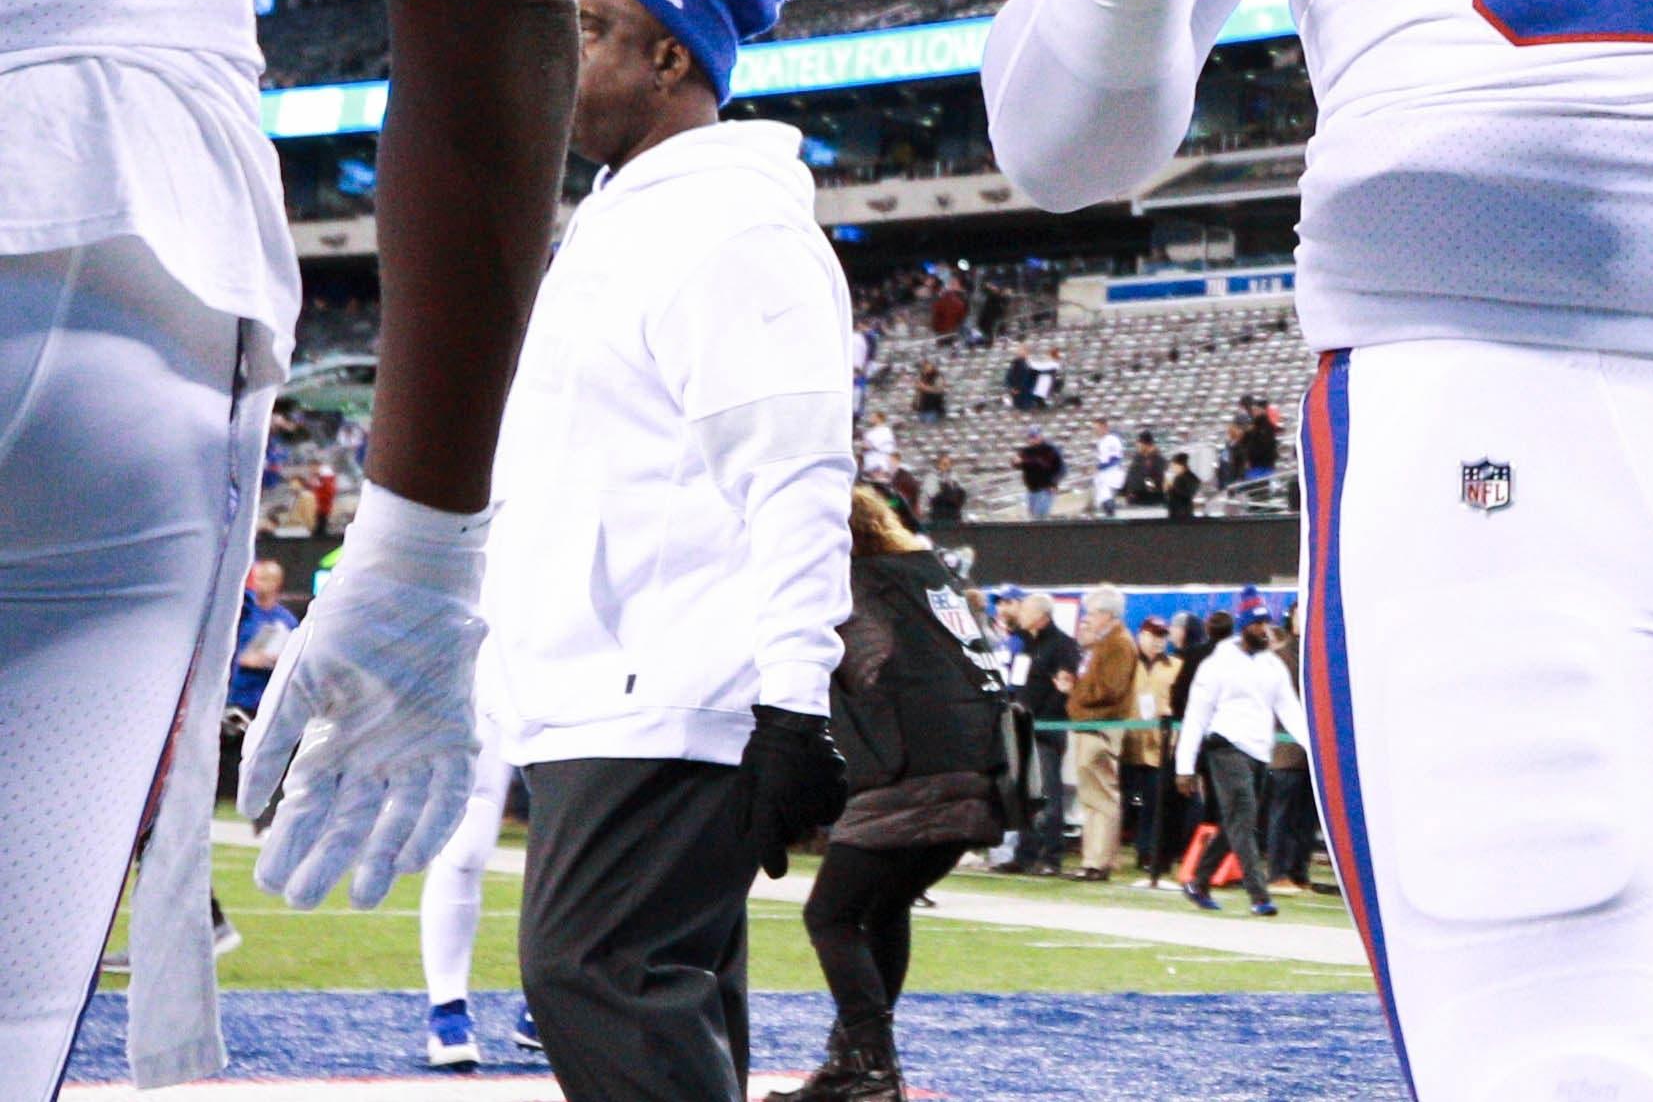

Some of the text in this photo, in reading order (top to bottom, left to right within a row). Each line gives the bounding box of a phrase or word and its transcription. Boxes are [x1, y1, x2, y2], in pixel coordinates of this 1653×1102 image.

[732, 30, 987, 93] DIATELY FOLLOW
[1467, 482, 1507, 507] NFL
